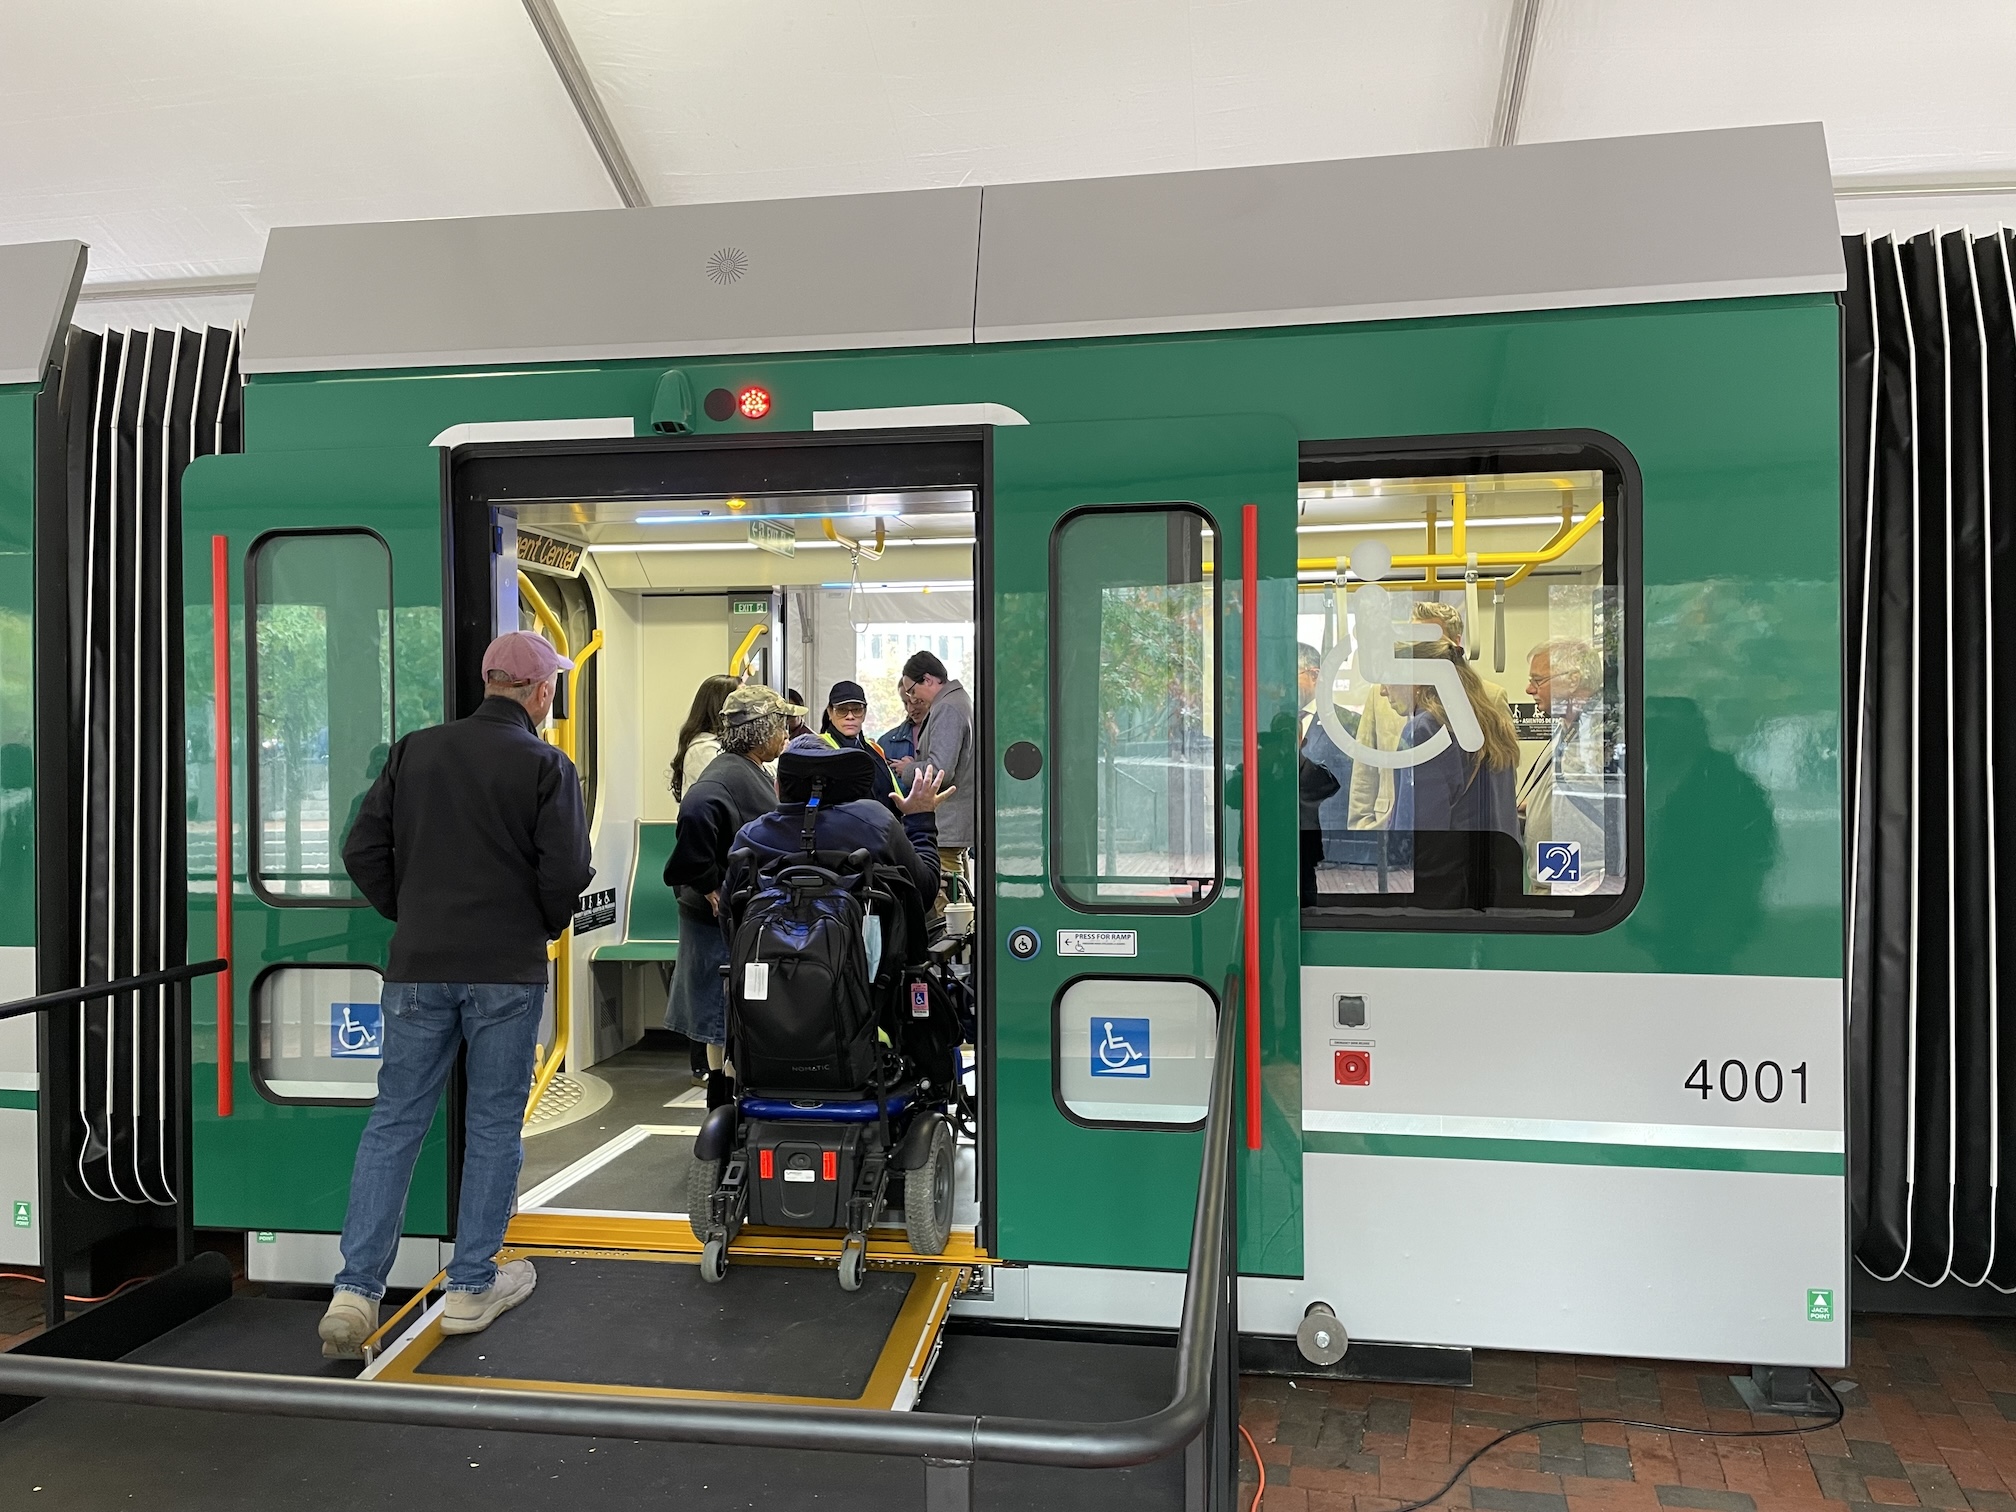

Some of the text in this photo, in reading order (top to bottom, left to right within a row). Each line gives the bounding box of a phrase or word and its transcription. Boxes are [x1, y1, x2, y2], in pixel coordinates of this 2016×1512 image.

[540, 539, 579, 571] Center
[739, 603, 753, 612] EXIT
[1568, 870, 1577, 880] T
[1684, 1059, 1806, 1104] 4001
